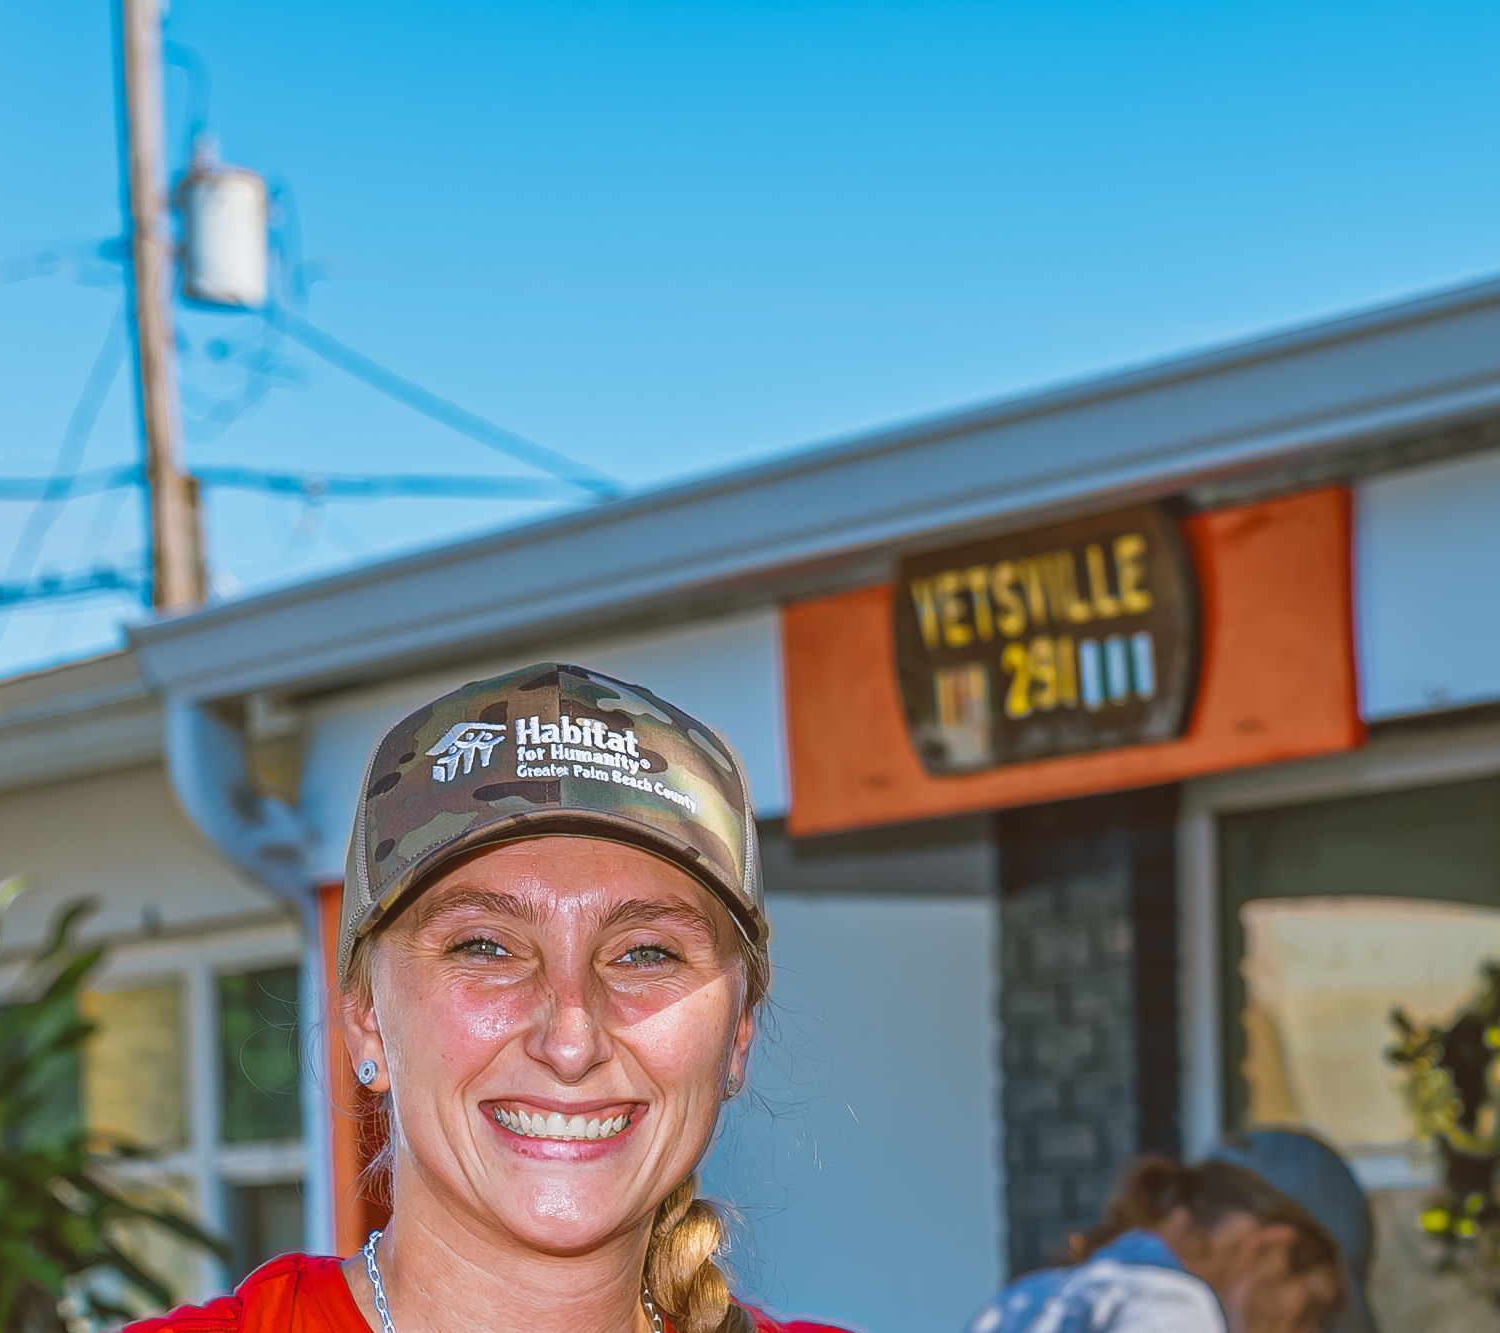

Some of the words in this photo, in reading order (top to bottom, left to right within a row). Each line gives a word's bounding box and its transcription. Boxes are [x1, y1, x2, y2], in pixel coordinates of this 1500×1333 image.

[515, 715, 640, 758] Habitat
[516, 746, 546, 761] for
[516, 763, 570, 778] Greater
[573, 764, 610, 782] Palm
[611, 770, 653, 793] Beach
[654, 781, 697, 814] County
